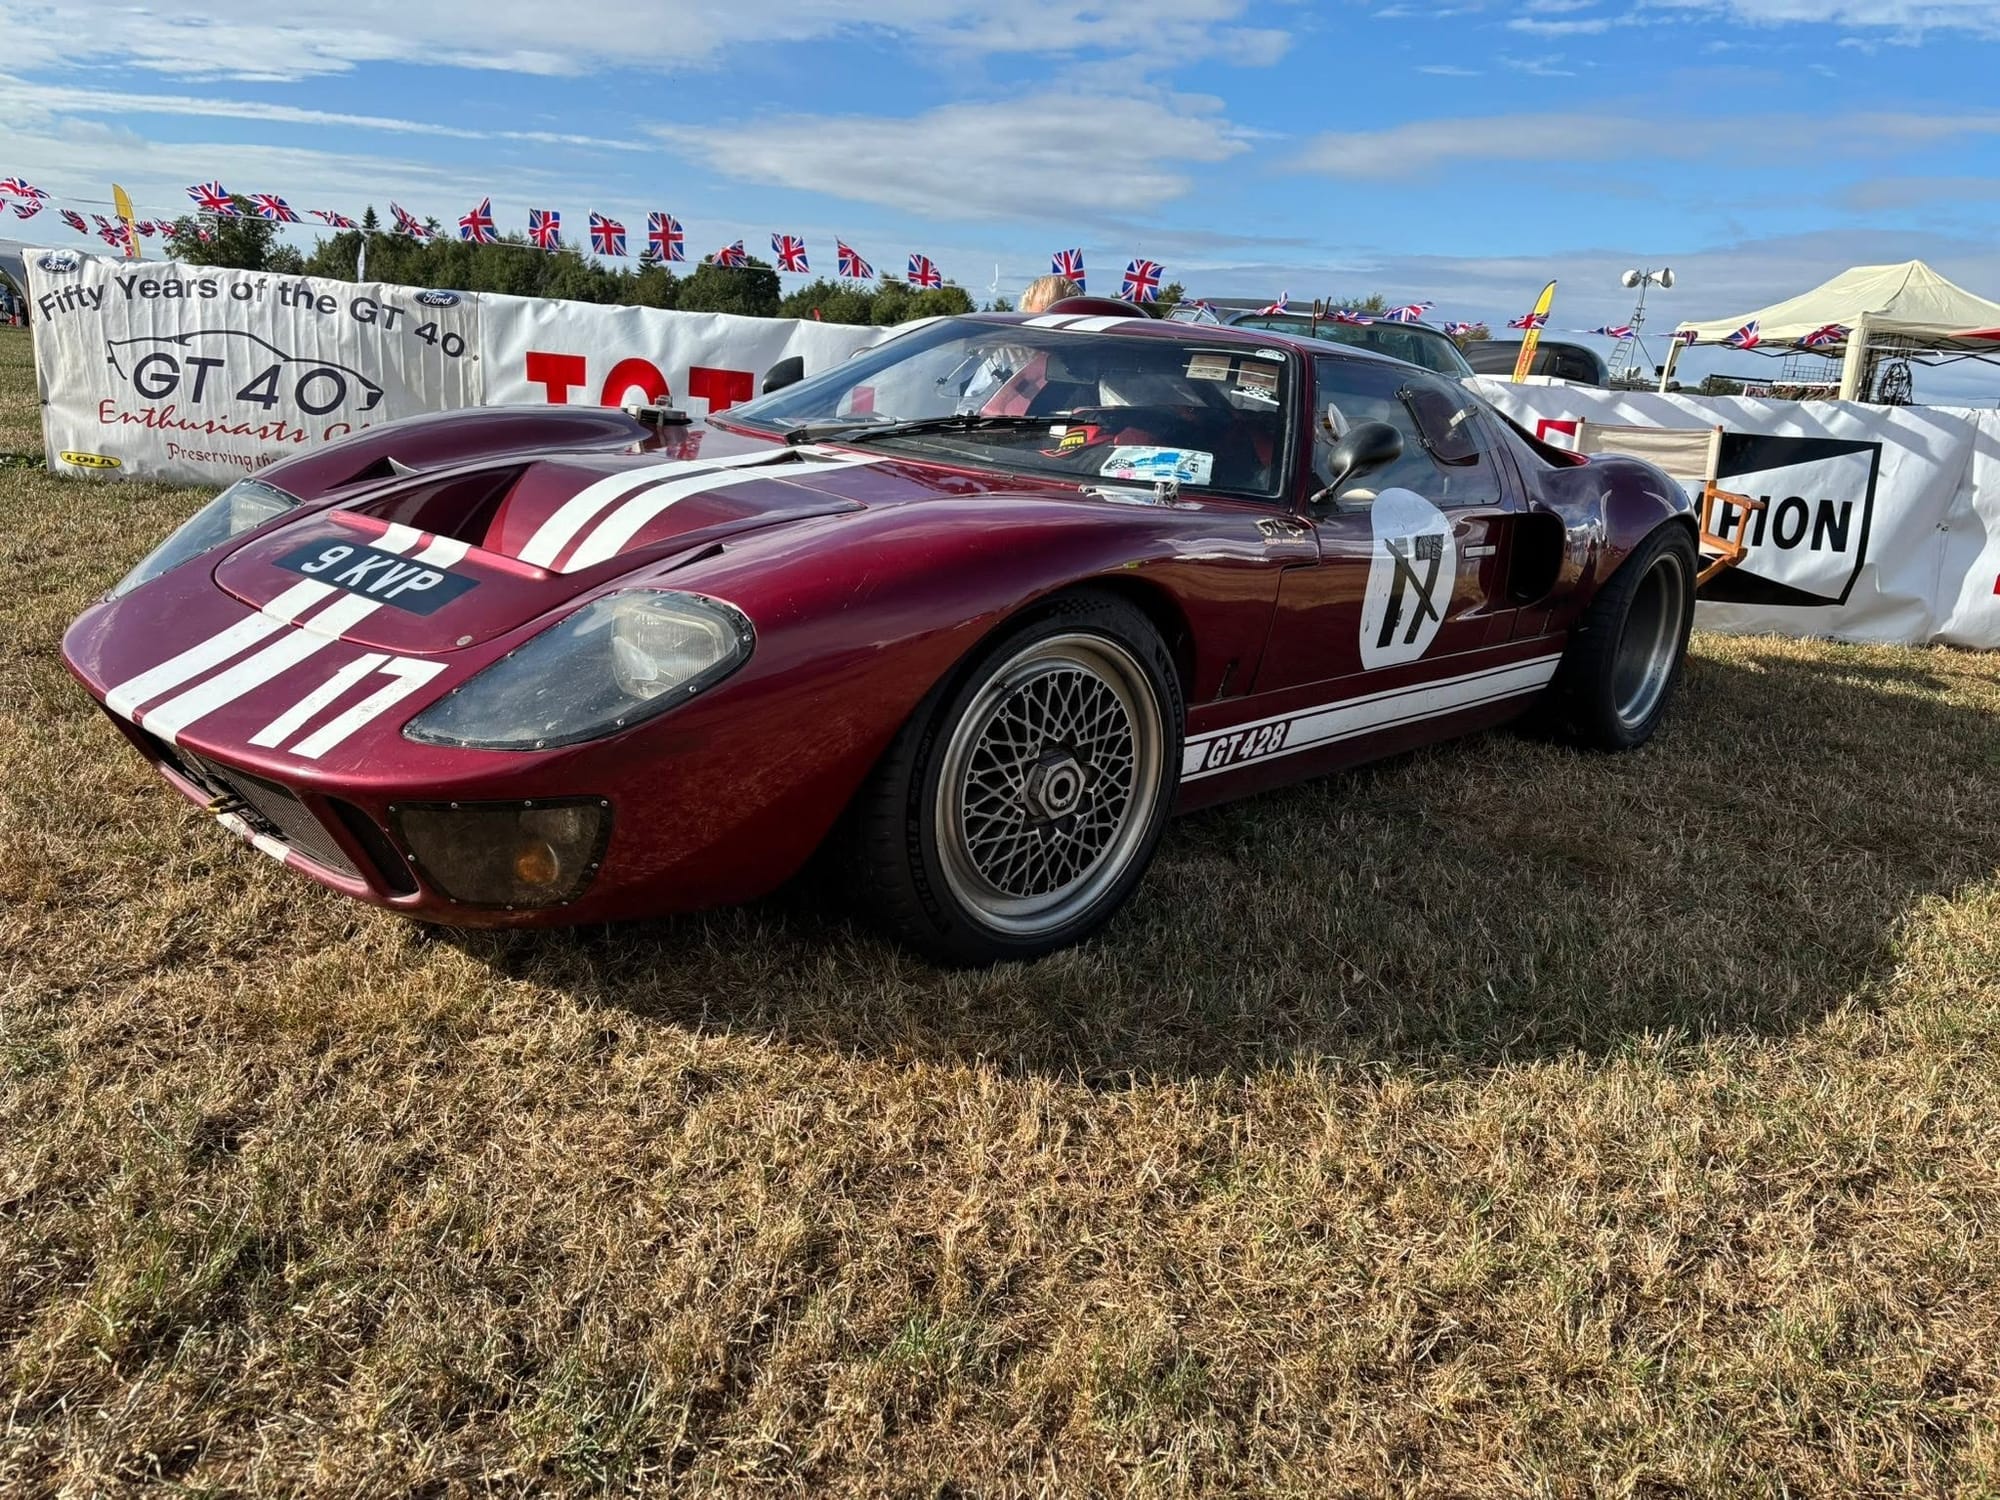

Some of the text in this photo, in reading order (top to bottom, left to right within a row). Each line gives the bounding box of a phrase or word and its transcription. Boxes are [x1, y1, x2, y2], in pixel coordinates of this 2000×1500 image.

[43, 256, 77, 272] Ford
[38, 275, 465, 358] Fifty Years of the GT 40
[421, 291, 455, 306] Ford
[133, 352, 347, 416] GT 40
[525, 351, 754, 414] TOT
[99, 399, 310, 444] Enthusiasts
[65, 453, 117, 467] LOLA
[167, 443, 253, 472] Preserving
[300, 545, 444, 599] 9 KVP
[247, 652, 449, 760] 17
[907, 818, 939, 914] MICHELIN
